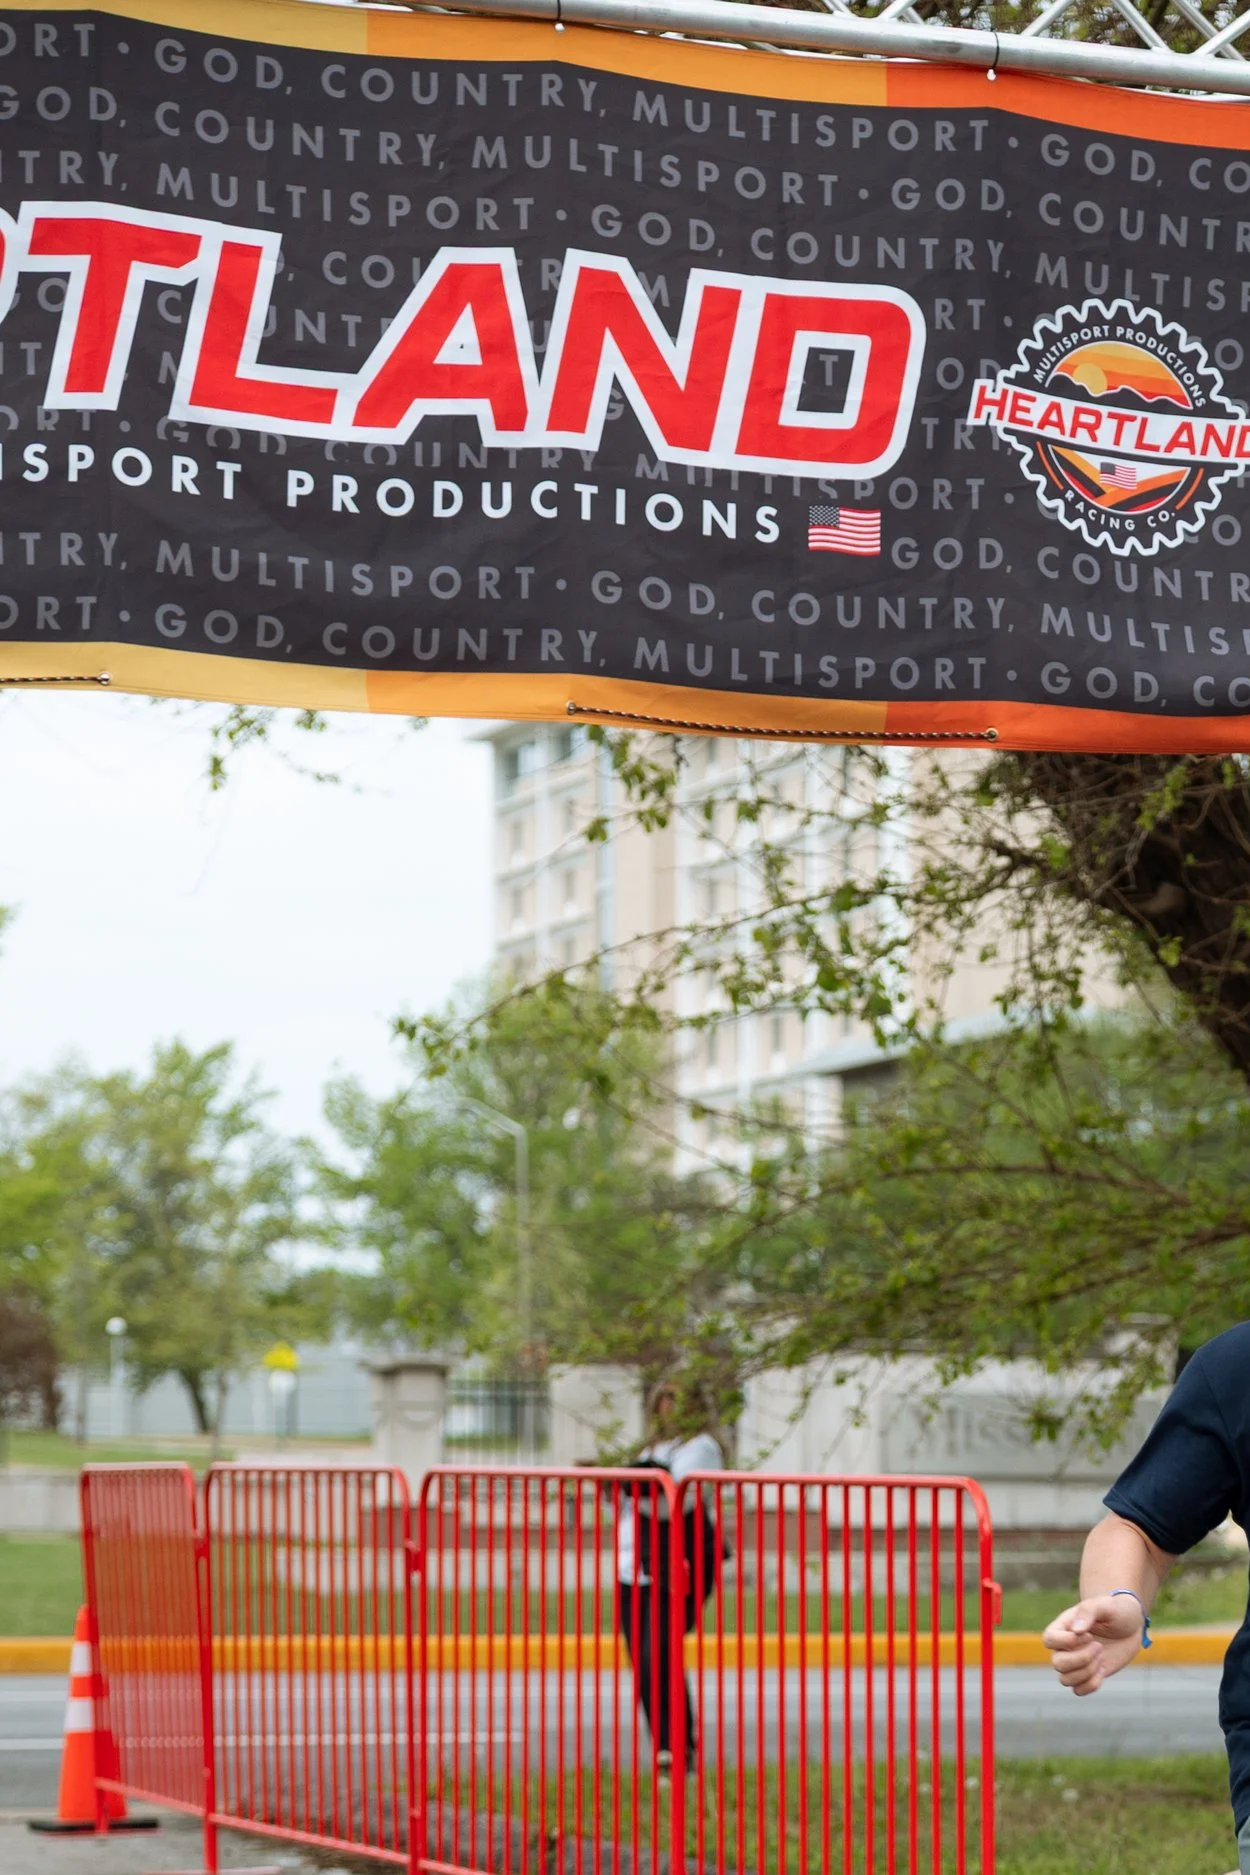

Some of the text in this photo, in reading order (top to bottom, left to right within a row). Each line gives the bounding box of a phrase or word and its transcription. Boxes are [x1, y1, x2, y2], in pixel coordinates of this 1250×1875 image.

[154, 38, 293, 96] GOD,
[320, 64, 606, 118] COUNTRY,
[632, 90, 989, 152] MULTISPORT
[1040, 133, 1162, 188] GOD,
[154, 101, 446, 171] COUNTRY,
[471, 135, 839, 207] MULTISPORT
[891, 177, 1013, 219] GOD,
[0, 150, 128, 192] TRY,
[156, 162, 535, 231] MULTISPORT
[590, 204, 724, 258] GOD,
[750, 227, 1012, 278] COUNTRY,
[0, 202, 926, 480] TLAND
[1032, 324, 1207, 408] MULTISPORT PRODUCTIONS
[0, 442, 781, 544] SPORT PRODUCTIONS
[1064, 489, 1136, 531] RACING
[0, 531, 128, 571] TRY,
[155, 539, 536, 600] MULTISPORT
[590, 570, 725, 621] GOD,
[751, 589, 1014, 632] COUNTRY,
[154, 604, 293, 653] GOD,
[322, 624, 606, 667] COUNTRY,
[633, 636, 987, 690] MULTISPORT
